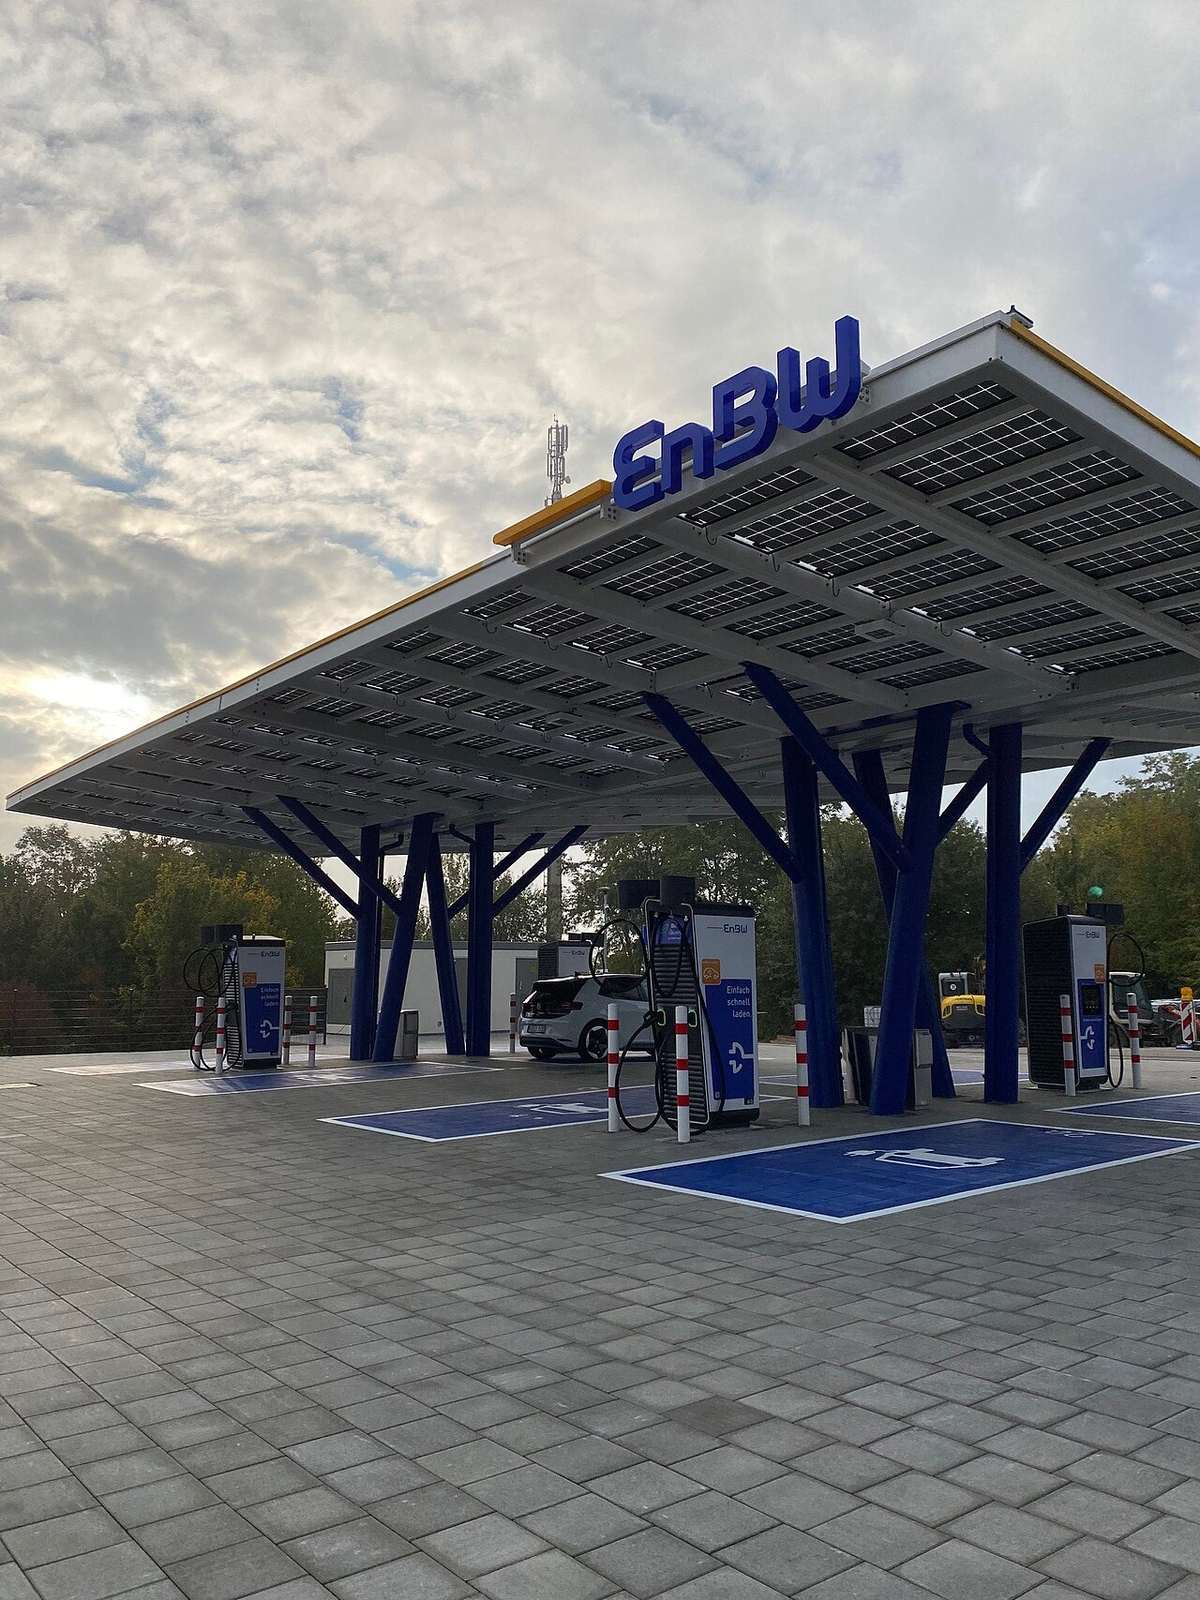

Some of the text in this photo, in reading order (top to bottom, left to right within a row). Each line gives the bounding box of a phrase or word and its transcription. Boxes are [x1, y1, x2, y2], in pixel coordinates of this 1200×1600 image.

[613, 315, 861, 512] EnBW
[723, 924, 748, 933] EnBW
[726, 986, 750, 994] Einfach
[732, 1010, 751, 1018] laden
